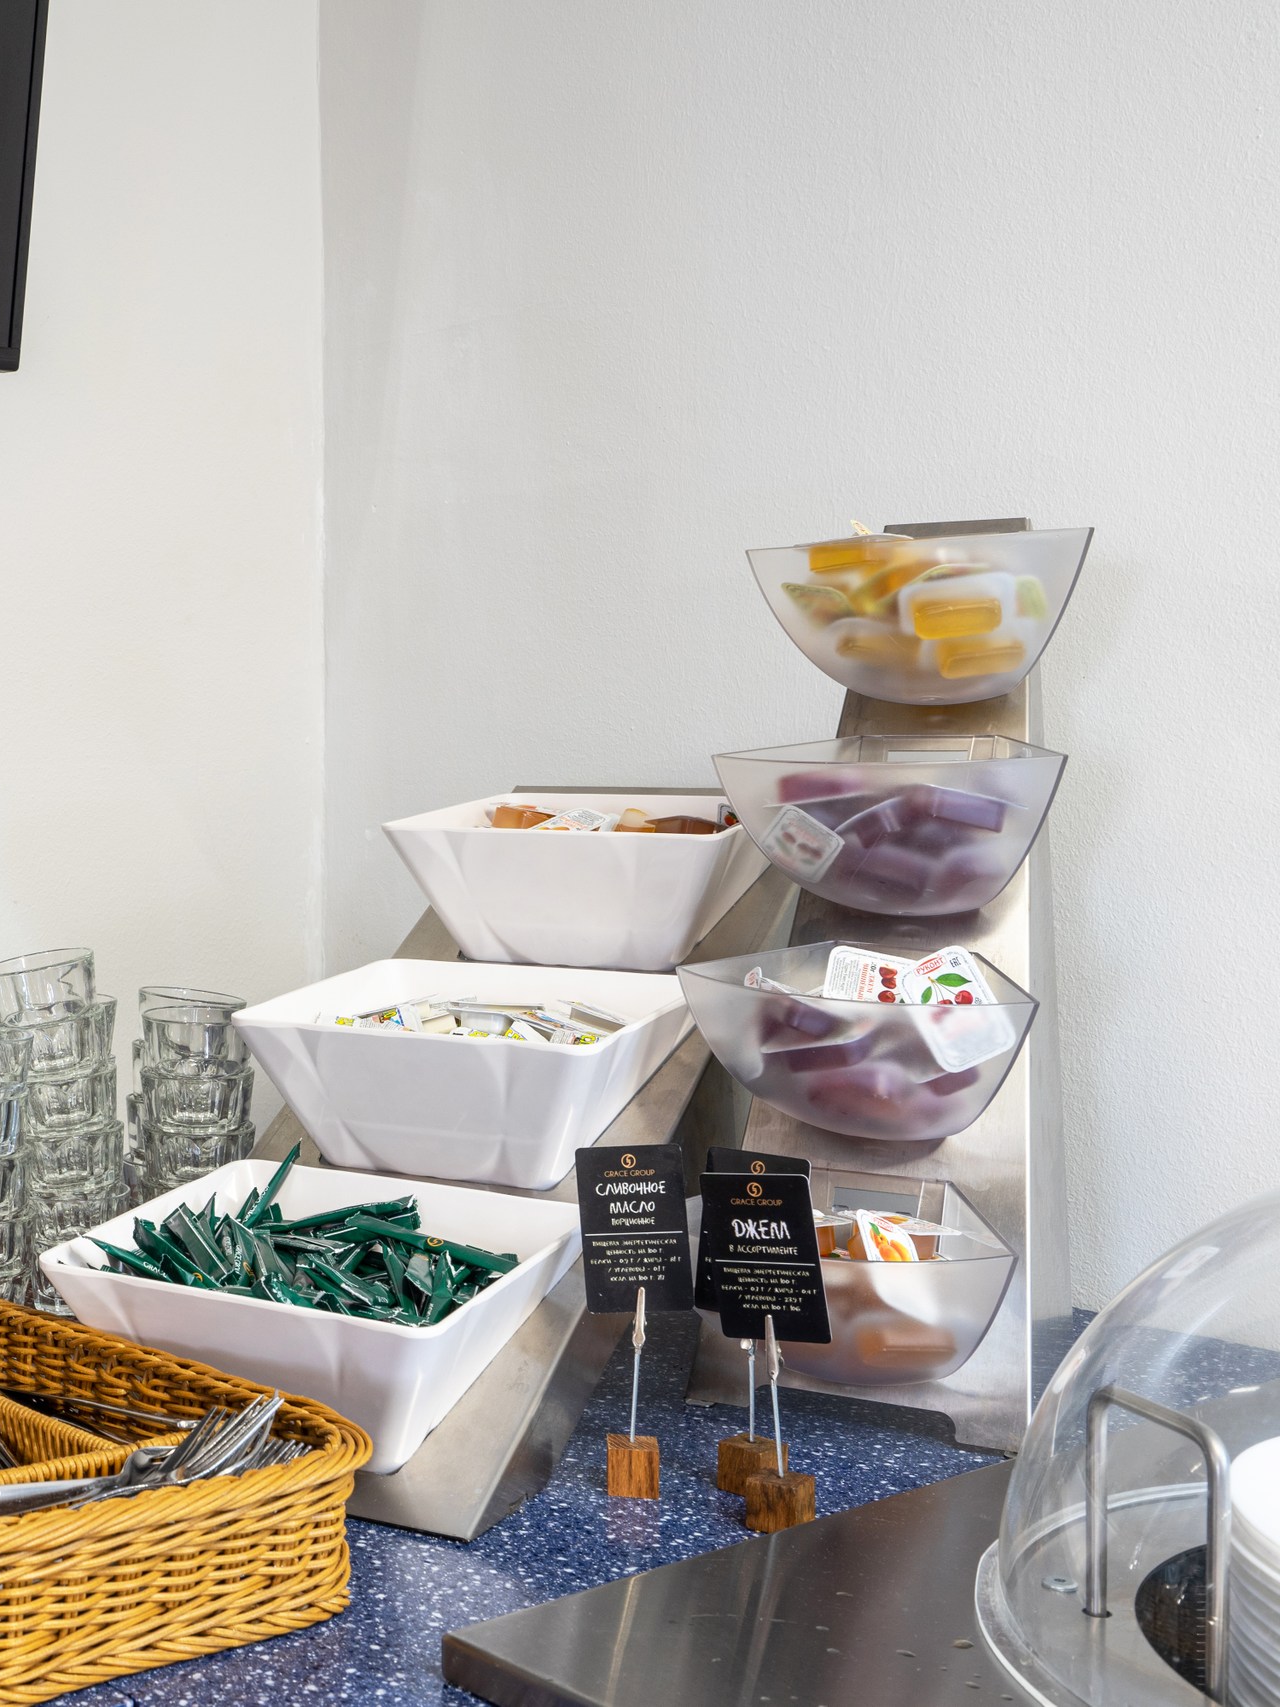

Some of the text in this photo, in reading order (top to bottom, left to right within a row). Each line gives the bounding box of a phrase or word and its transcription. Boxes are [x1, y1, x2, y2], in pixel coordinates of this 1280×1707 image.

[916, 958, 945, 975] РУКОНТ
[604, 1169, 656, 1178] GRACE GROUP
[596, 1180, 667, 1196] СЛИВОЧНОЕ
[609, 1200, 656, 1214] МАСЛО
[611, 1217, 655, 1226] ПОРЦИОННОЕ
[731, 1218, 791, 1240] ДЖЕМ
[737, 1245, 799, 1255] АССОРТИМЕНТЕ
[753, 1269, 810, 1277] ЭНЕРГЕТИЧЕСКАЯ
